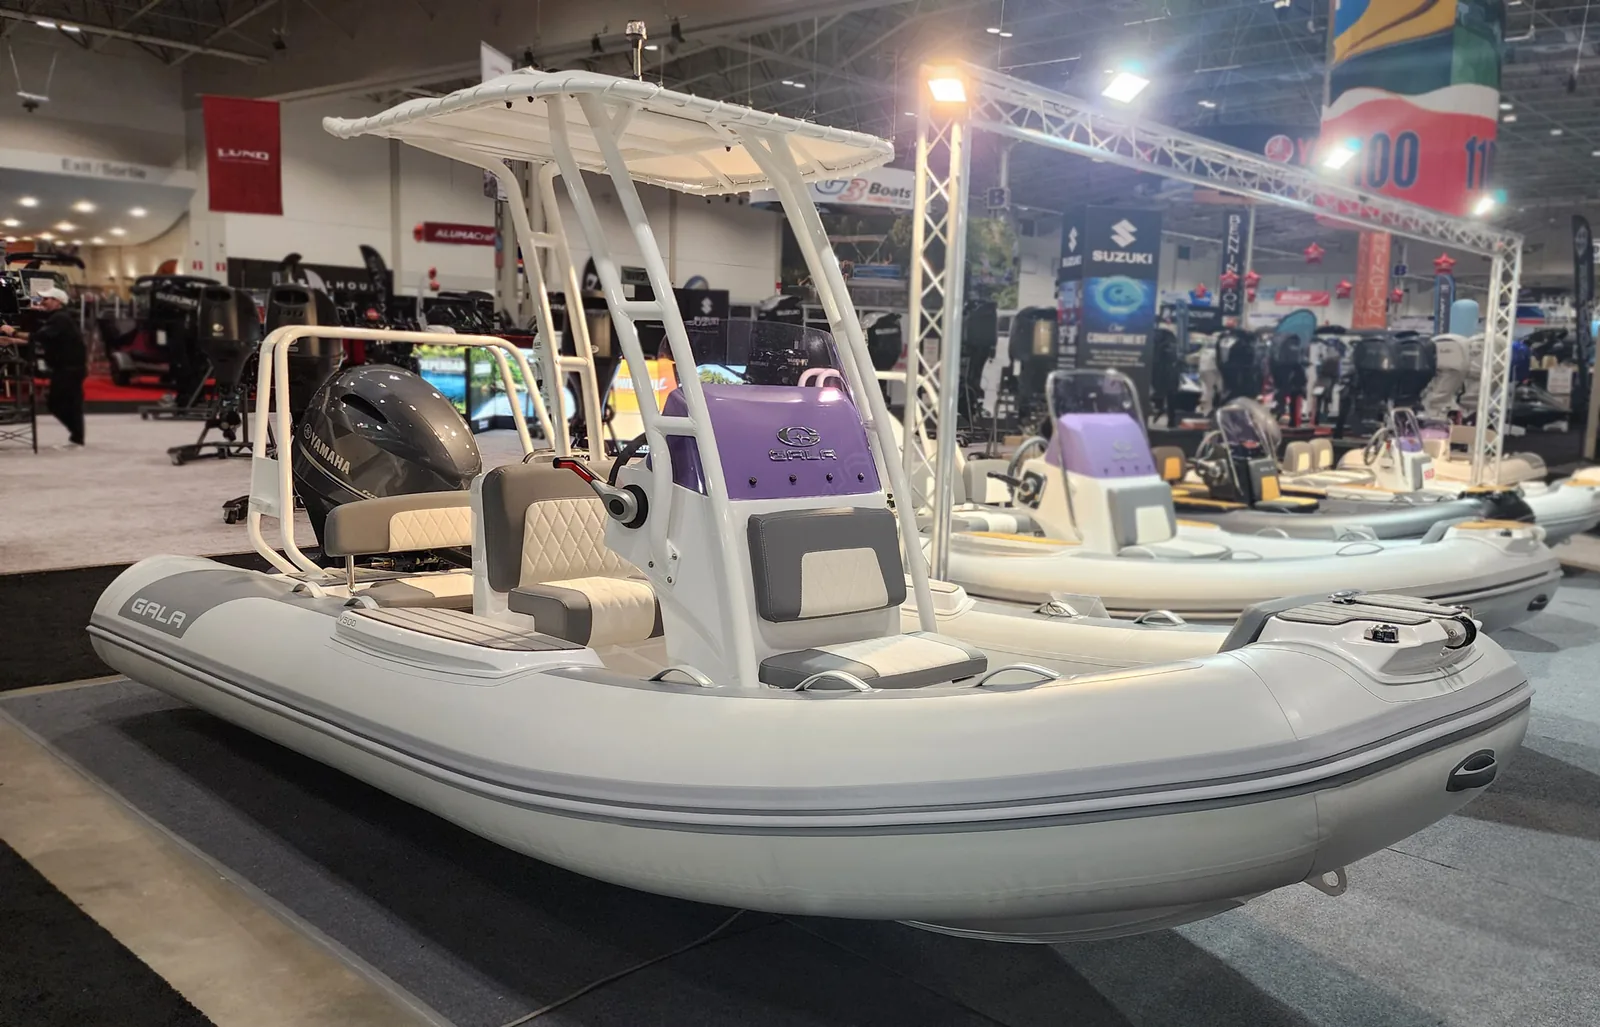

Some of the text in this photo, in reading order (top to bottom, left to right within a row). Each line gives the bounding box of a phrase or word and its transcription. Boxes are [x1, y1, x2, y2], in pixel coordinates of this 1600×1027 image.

[217, 148, 269, 161] LUND
[868, 182, 912, 200] Boats
[1092, 250, 1153, 264] SUZUKI
[310, 432, 351, 475] YAMAHA
[768, 449, 837, 461] GALA
[131, 597, 187, 629] GALA
